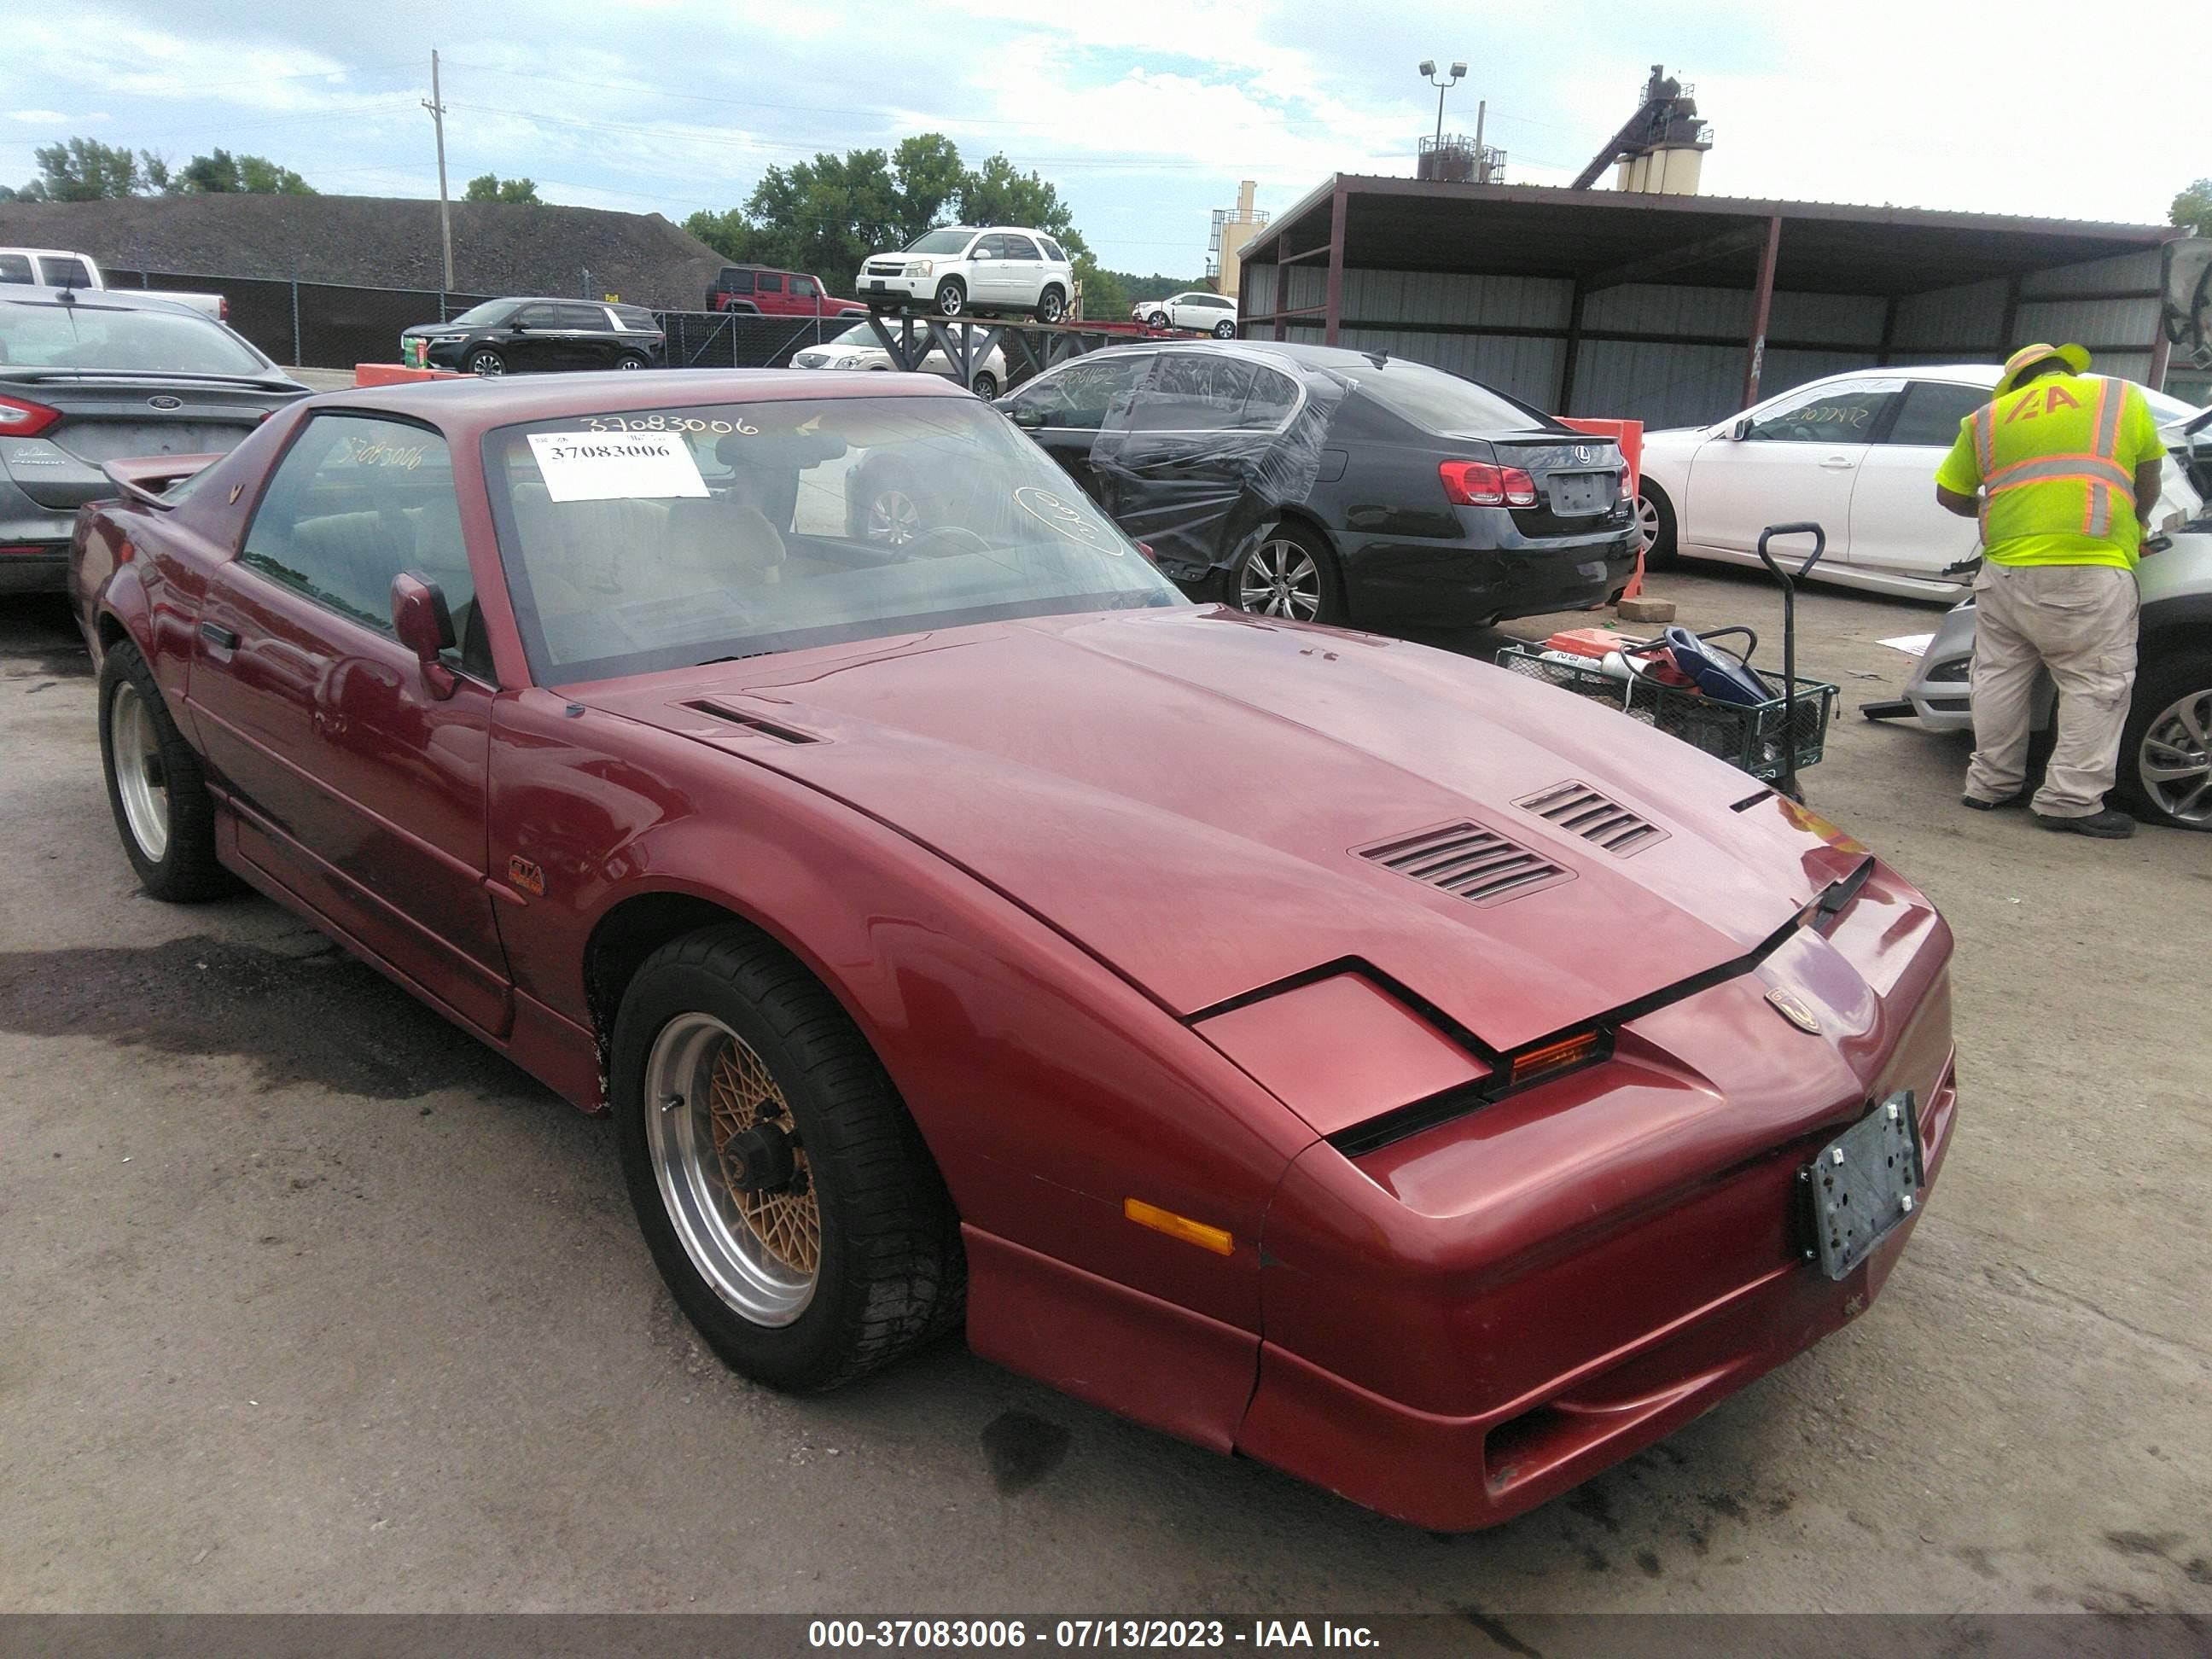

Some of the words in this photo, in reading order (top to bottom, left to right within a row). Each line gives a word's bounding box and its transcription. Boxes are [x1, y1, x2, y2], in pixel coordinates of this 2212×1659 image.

[580, 415, 759, 435] 37083006
[338, 437, 428, 470] 37083006
[550, 445, 670, 460] 37083006
